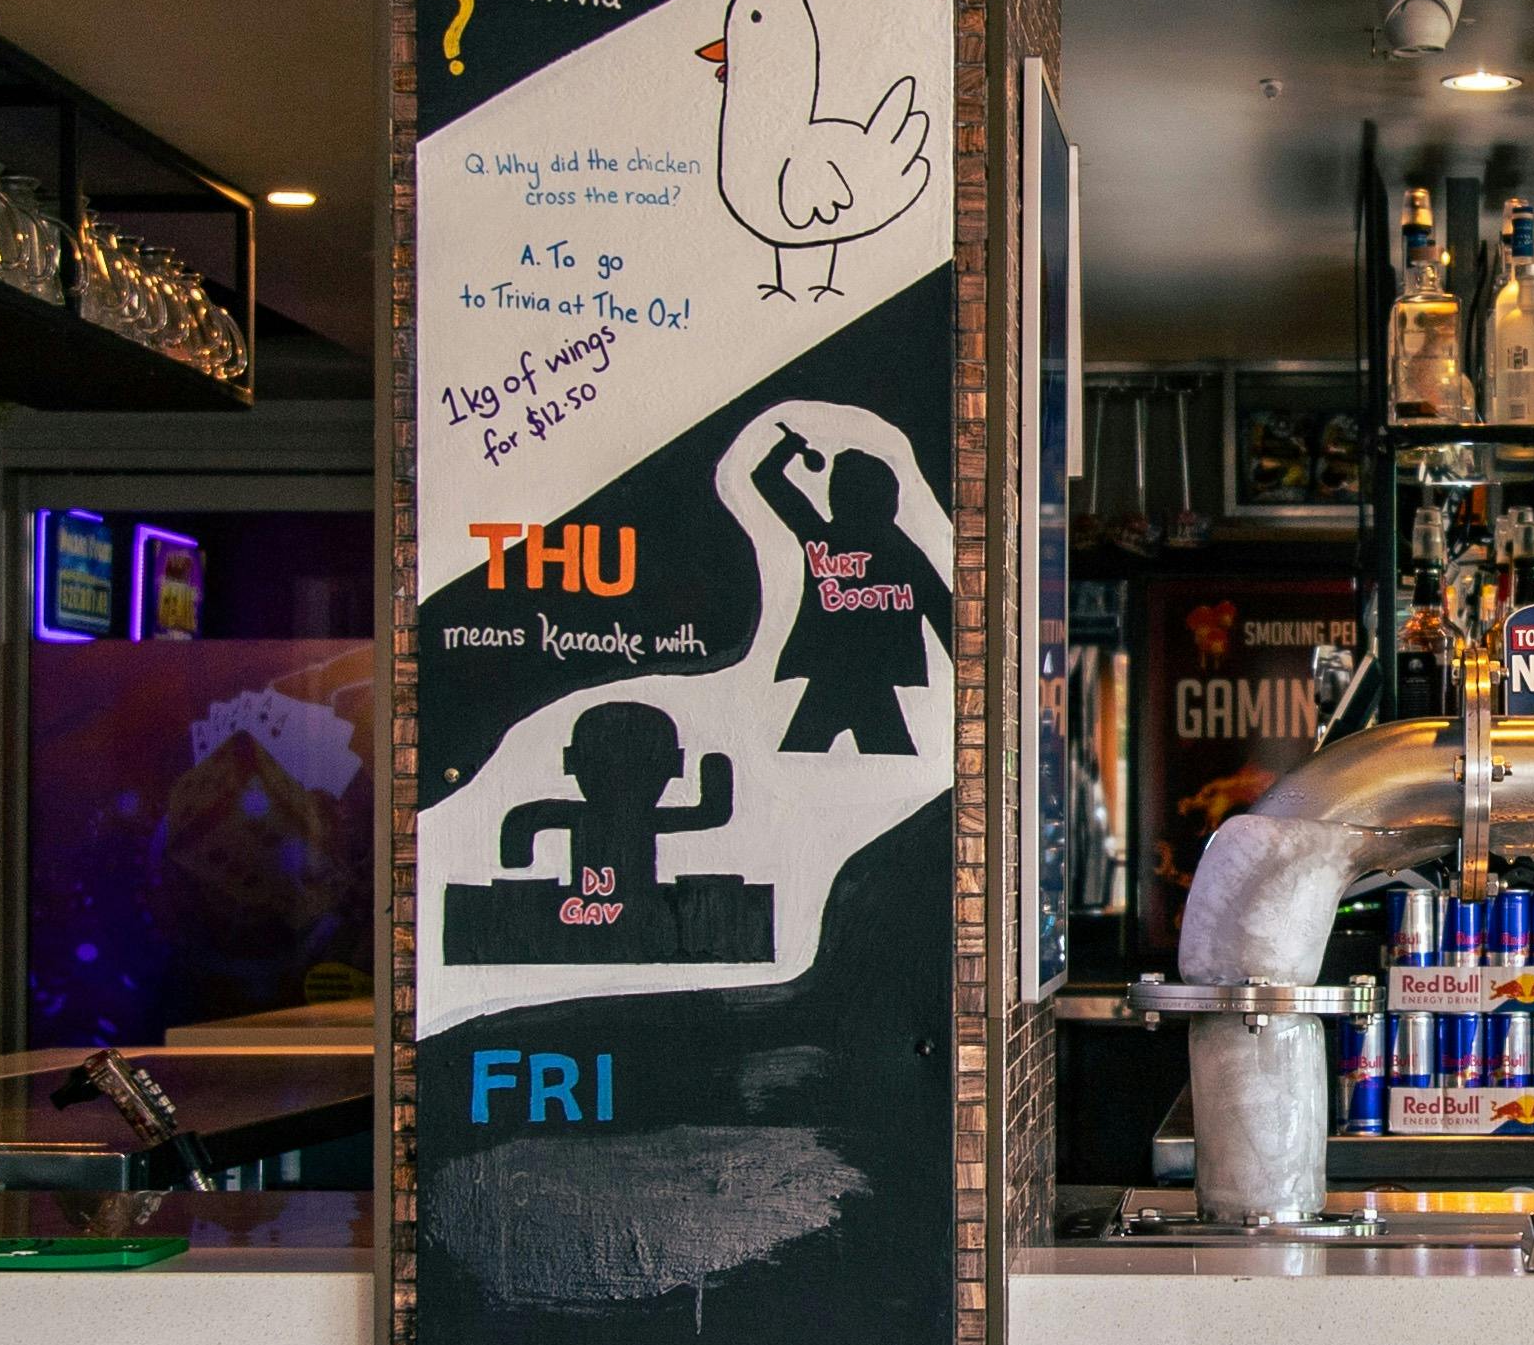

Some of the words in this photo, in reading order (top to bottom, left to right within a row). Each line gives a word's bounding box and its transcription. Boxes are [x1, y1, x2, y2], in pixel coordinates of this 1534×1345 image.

[496, 155, 540, 188] Why
[549, 151, 580, 173] did
[586, 148, 619, 172] the
[626, 149, 702, 176] chicken
[524, 188, 576, 206] cross
[584, 185, 619, 205] the
[624, 185, 682, 207] road?
[546, 240, 576, 270] To
[597, 254, 624, 280] go
[459, 283, 486, 309] to
[491, 281, 551, 314] Trivia
[558, 286, 585, 316] at
[592, 290, 639, 325] The
[647, 298, 691, 331] Ox!
[441, 382, 500, 427] 1kg
[502, 351, 539, 395] of
[544, 325, 617, 374] wings
[483, 428, 520, 467] for
[468, 522, 637, 598] THU
[443, 625, 526, 650] means
[654, 623, 708, 656] with
[1243, 621, 1325, 647] SMOKING
[1329, 621, 1358, 646] PE
[1176, 678, 1317, 739] GAMIN
[581, 866, 617, 896] DJ
[559, 897, 624, 926] GAV
[1401, 974, 1442, 994] Red
[1444, 974, 1480, 994] Bull
[1401, 996, 1443, 1005] ENERGY
[1446, 996, 1480, 1005] DRINK
[471, 1049, 614, 1124] FRI
[1402, 1095, 1442, 1115] Red
[1444, 1095, 1480, 1115] Bull
[1402, 1117, 1443, 1126] ENERGY
[1447, 1117, 1480, 1126] DRINK
